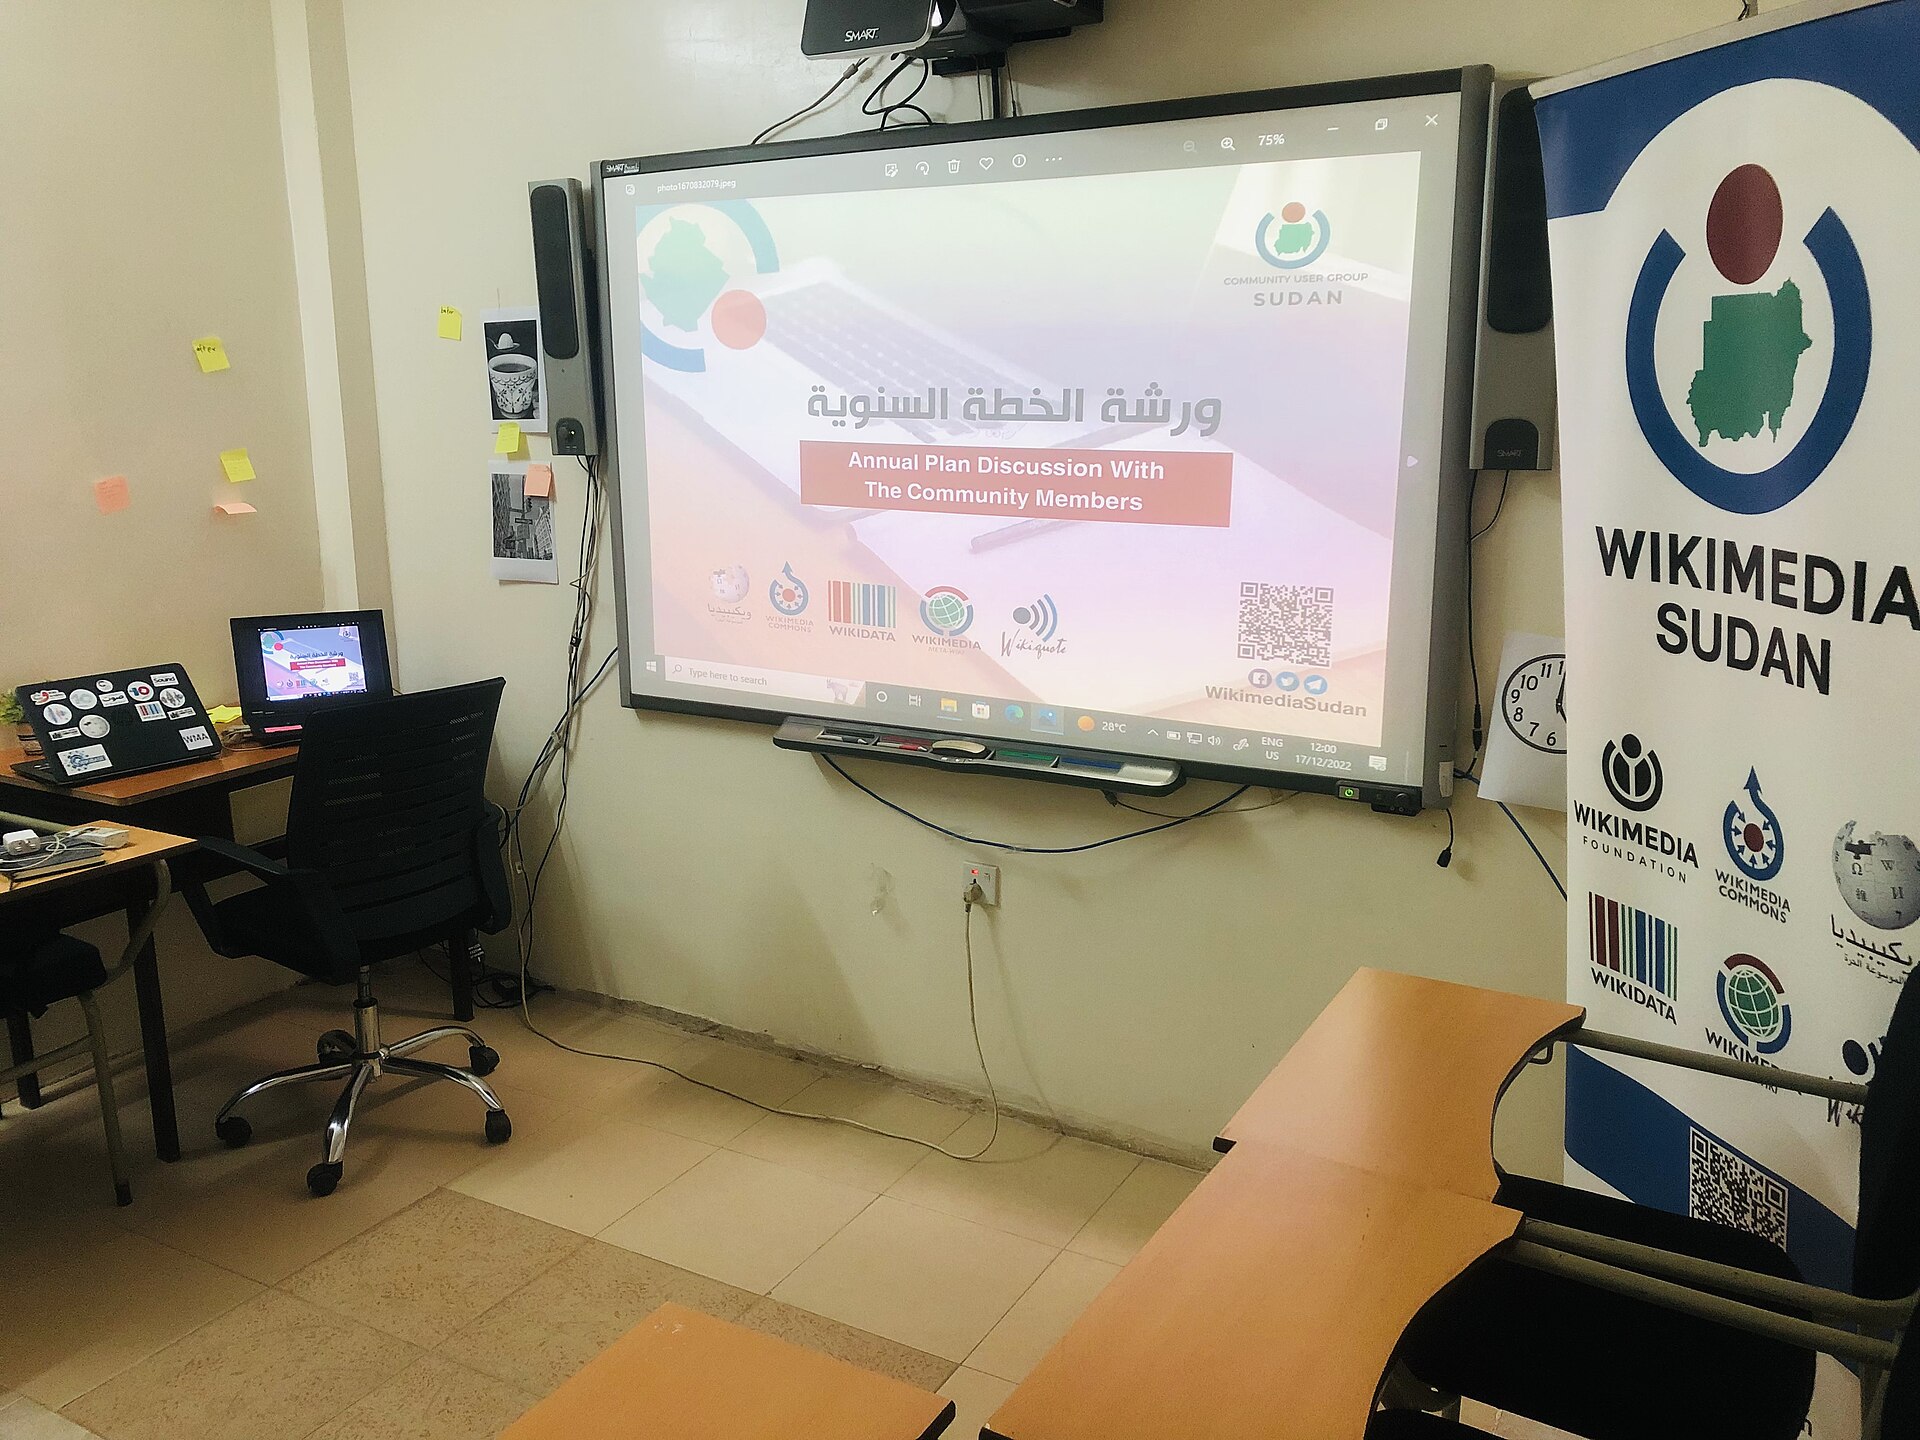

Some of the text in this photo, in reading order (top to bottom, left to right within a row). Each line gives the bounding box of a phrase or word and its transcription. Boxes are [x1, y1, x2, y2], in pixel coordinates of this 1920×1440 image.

[844, 27, 879, 42] SMART
[1258, 133, 1285, 147] 75%
[657, 180, 736, 194] photo1670832079.jpeg
[1223, 272, 1369, 286] COMMUNITY USER GROUP
[1253, 289, 1342, 307] SUDAN
[807, 381, 1222, 436] ورشة الخطة السنوية
[848, 451, 1165, 481] Annual Plan Discussion With
[864, 480, 1143, 512] The Community Members
[1595, 526, 1920, 631] WIKIMEDIA
[765, 615, 814, 627] WIKIMEDIA
[768, 622, 812, 633] COMMONS
[829, 625, 896, 642] WIKIDATA
[912, 634, 981, 650] WIKIMEDIA
[1001, 628, 1067, 660] Wikiquote
[1656, 602, 1831, 696] SUDAN
[688, 667, 768, 686] Type here to search
[1540, 662, 1552, 679] 11
[1520, 674, 1538, 691] 10
[1205, 685, 1367, 718] WikimediaSudan
[1511, 689, 1521, 704] 9
[1513, 707, 1523, 722] 8
[1102, 721, 1127, 733] 28°C
[1529, 721, 1540, 737] 7
[1261, 736, 1284, 748] ENG
[1546, 731, 1556, 746] 6
[1265, 751, 1280, 761] US
[1310, 742, 1337, 754] 12:00
[1295, 754, 1352, 771] 17/12/2022
[1573, 799, 1699, 868] WIKIMEDIA
[1582, 835, 1687, 884] FOUNDATION
[1714, 868, 1791, 912] WIKIMEDIA
[1718, 884, 1787, 924] COMMONS
[1590, 967, 1677, 1025] WIKIDATA
